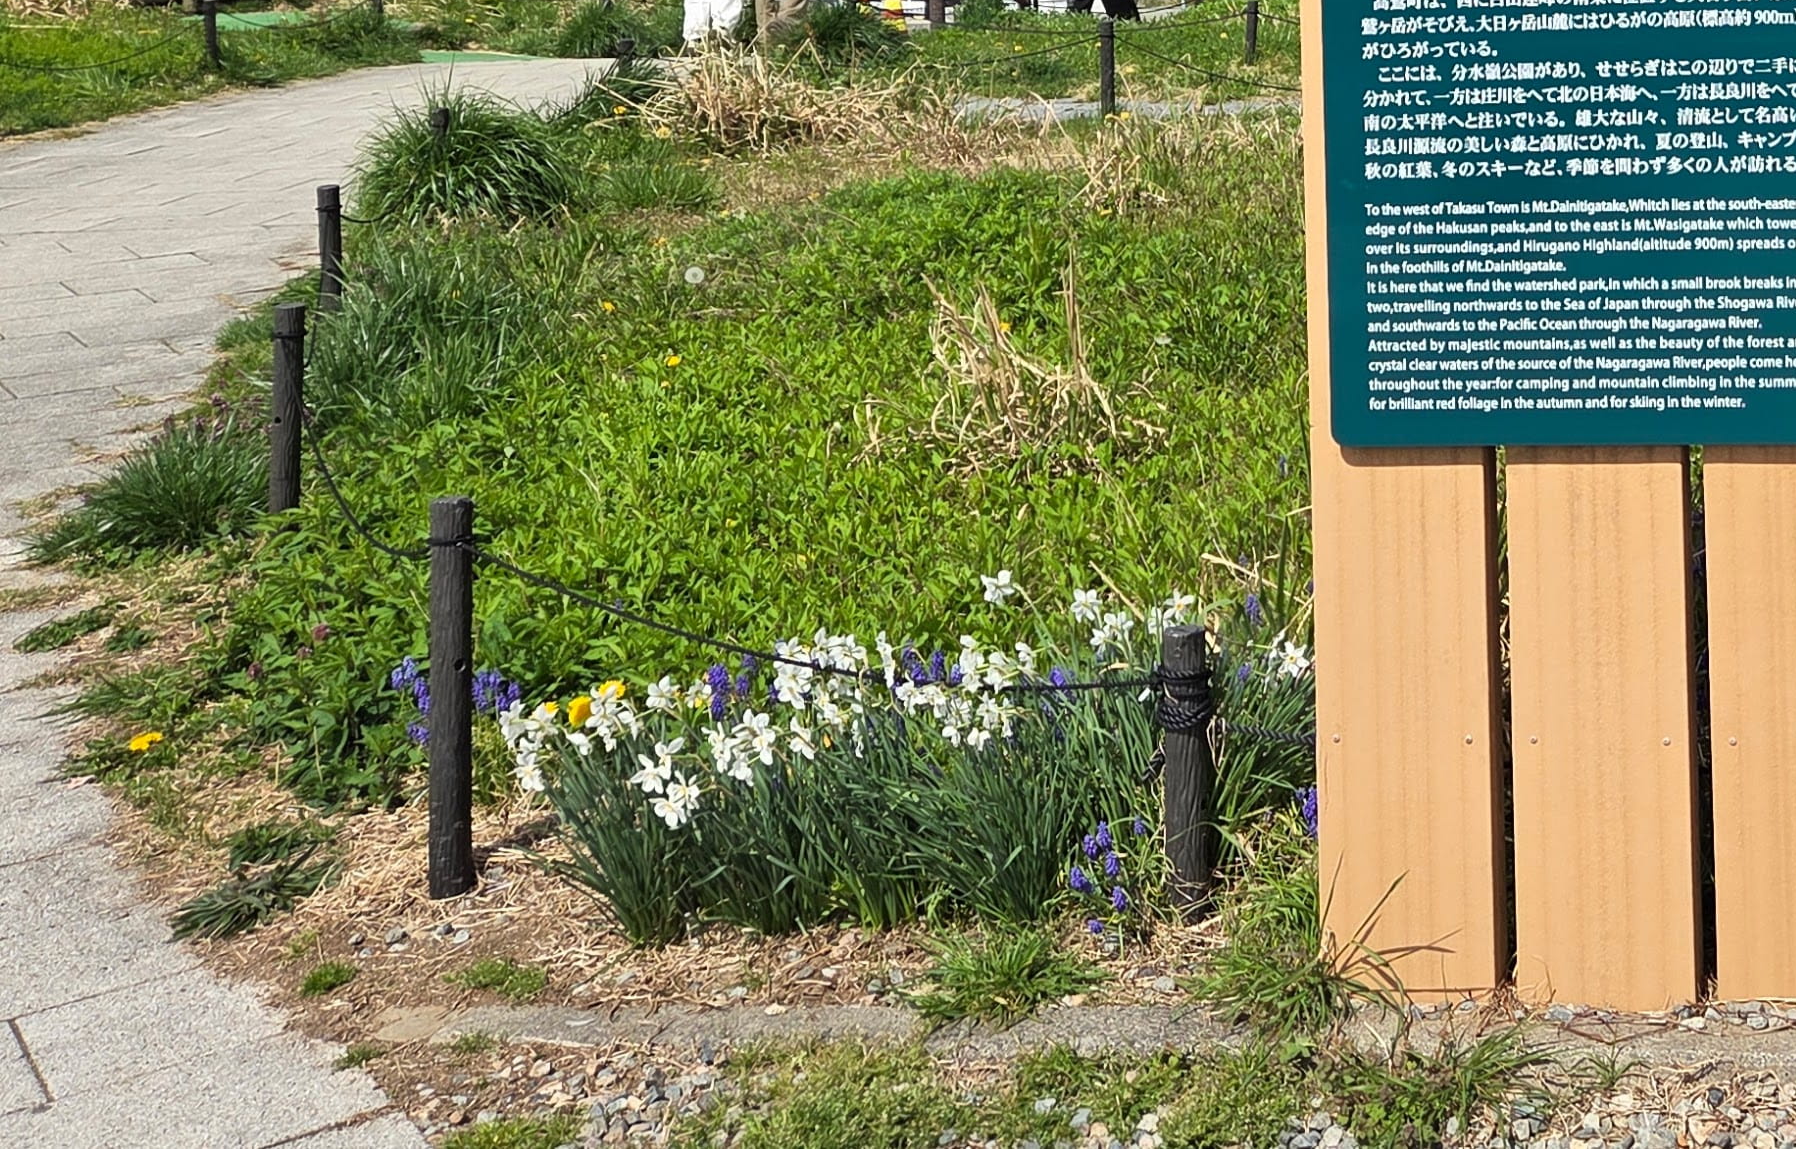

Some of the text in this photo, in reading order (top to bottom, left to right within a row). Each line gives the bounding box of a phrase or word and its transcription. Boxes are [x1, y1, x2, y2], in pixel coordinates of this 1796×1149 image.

[1361, 39, 1498, 59] がひろがっている。
[1365, 222, 1396, 238] edge
[1397, 221, 1411, 235] of
[1412, 221, 1434, 234] the
[1435, 220, 1487, 234] Hakusan
[1554, 220, 1568, 232] to
[1569, 218, 1591, 232] the
[1592, 219, 1619, 232] east
[1621, 218, 1632, 231] is
[1726, 216, 1763, 230] which
[1365, 244, 1394, 255] over
[1395, 241, 1410, 254] its
[1523, 238, 1581, 255] Hirugano
[1736, 236, 1785, 252] spreads
[1366, 261, 1378, 274] in
[1379, 261, 1400, 274] the
[1401, 260, 1450, 273] foothills
[1451, 259, 1465, 272] of
[1367, 281, 1376, 294] It
[1378, 281, 1388, 293] is
[1389, 280, 1417, 293] here
[1418, 279, 1444, 292] that
[1445, 282, 1464, 292] we
[1465, 278, 1490, 292] find
[1491, 278, 1512, 292] the
[1513, 277, 1577, 291] watershed
[1622, 276, 1659, 290] which
[1661, 279, 1669, 290] a
[1671, 276, 1703, 289] small
[1705, 276, 1741, 289] brook
[1743, 275, 1784, 289] breaks
[1453, 297, 1522, 311] northwards
[1524, 299, 1539, 310] to
[1540, 297, 1561, 310] the
[1563, 297, 1585, 310] Sea
[1587, 296, 1601, 310] of
[1602, 297, 1639, 312] Japan
[1641, 295, 1692, 312] through
[1693, 295, 1715, 309] the
[1717, 295, 1774, 311] Shogawa
[1367, 319, 1390, 332] and
[1392, 318, 1460, 332] southwards
[1462, 319, 1475, 331] to
[1477, 317, 1497, 331] the
[1499, 317, 1537, 330] Pacific
[1538, 317, 1577, 330] Ocean
[1578, 316, 1627, 332] through
[1628, 316, 1649, 329] the
[1651, 315, 1726, 332] Nagaragawa
[1367, 338, 1426, 352] Attracted
[1429, 338, 1446, 353] by
[1447, 338, 1500, 353] majestic
[1589, 336, 1615, 349] well
[1618, 338, 1633, 349] as
[1635, 336, 1657, 349] the
[1659, 335, 1704, 351] beauty
[1706, 335, 1720, 348] of
[1722, 335, 1744, 348] the
[1746, 334, 1784, 348] forest
[1368, 358, 1406, 374] crystal
[1408, 357, 1438, 370] clear
[1438, 359, 1479, 370] waters
[1481, 356, 1494, 370] of
[1494, 356, 1516, 370] the
[1517, 359, 1557, 369] source
[1558, 355, 1572, 369] of
[1573, 356, 1594, 369] the
[1595, 356, 1670, 372] Nagaragawa
[1749, 357, 1783, 368] come
[1368, 377, 1440, 393] throughout
[1441, 376, 1463, 390] the
[1515, 376, 1569, 392] camping
[1572, 375, 1596, 388] and
[1598, 375, 1659, 388] mountain
[1661, 374, 1716, 391] climbing
[1719, 375, 1732, 388] in
[1734, 374, 1756, 388] the
[1369, 396, 1387, 410] for
[1388, 396, 1434, 410] brilliant
[1435, 396, 1455, 409] red
[1457, 395, 1498, 412] foliage
[1500, 396, 1512, 409] in
[1513, 396, 1534, 409] the
[1536, 397, 1583, 409] autumn
[1584, 395, 1608, 408] and
[1609, 395, 1628, 408] for
[1667, 395, 1679, 408] in
[1680, 394, 1701, 407] the
